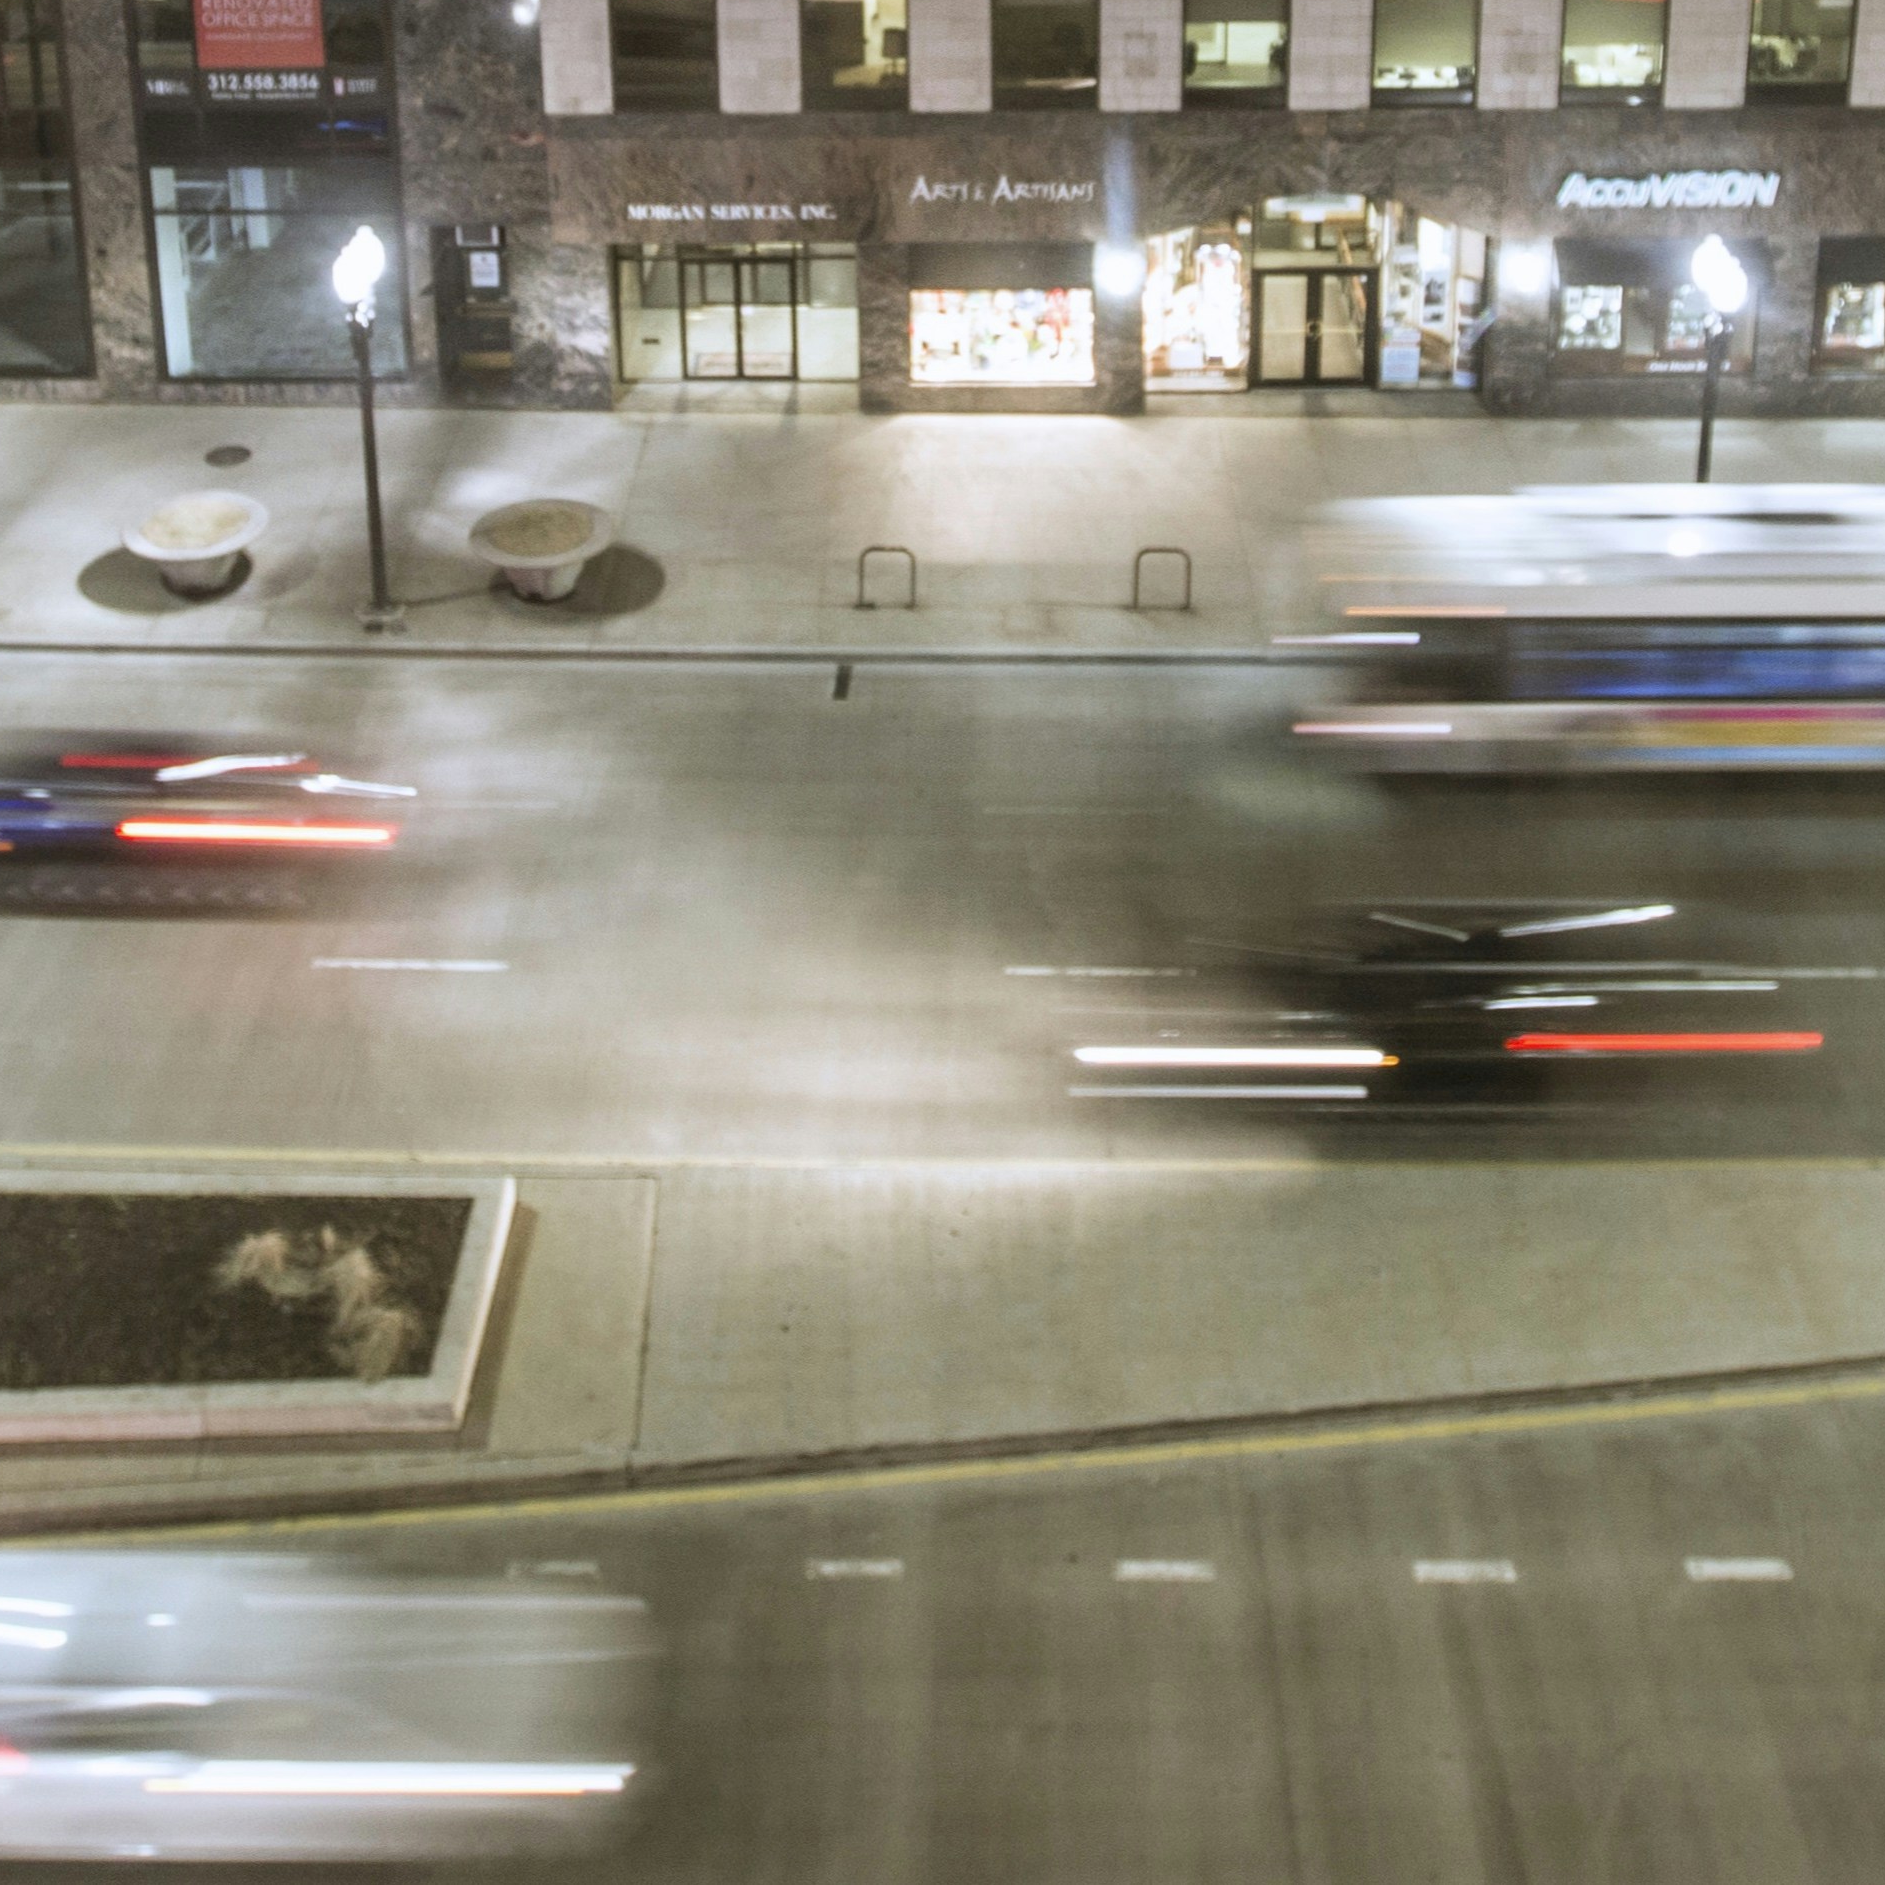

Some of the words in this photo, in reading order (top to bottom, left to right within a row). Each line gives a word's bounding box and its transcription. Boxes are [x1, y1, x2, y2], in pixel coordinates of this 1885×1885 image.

[202, 11, 257, 27] OFFICE
[262, 10, 313, 27] SPACE
[627, 204, 706, 221] MORGAN
